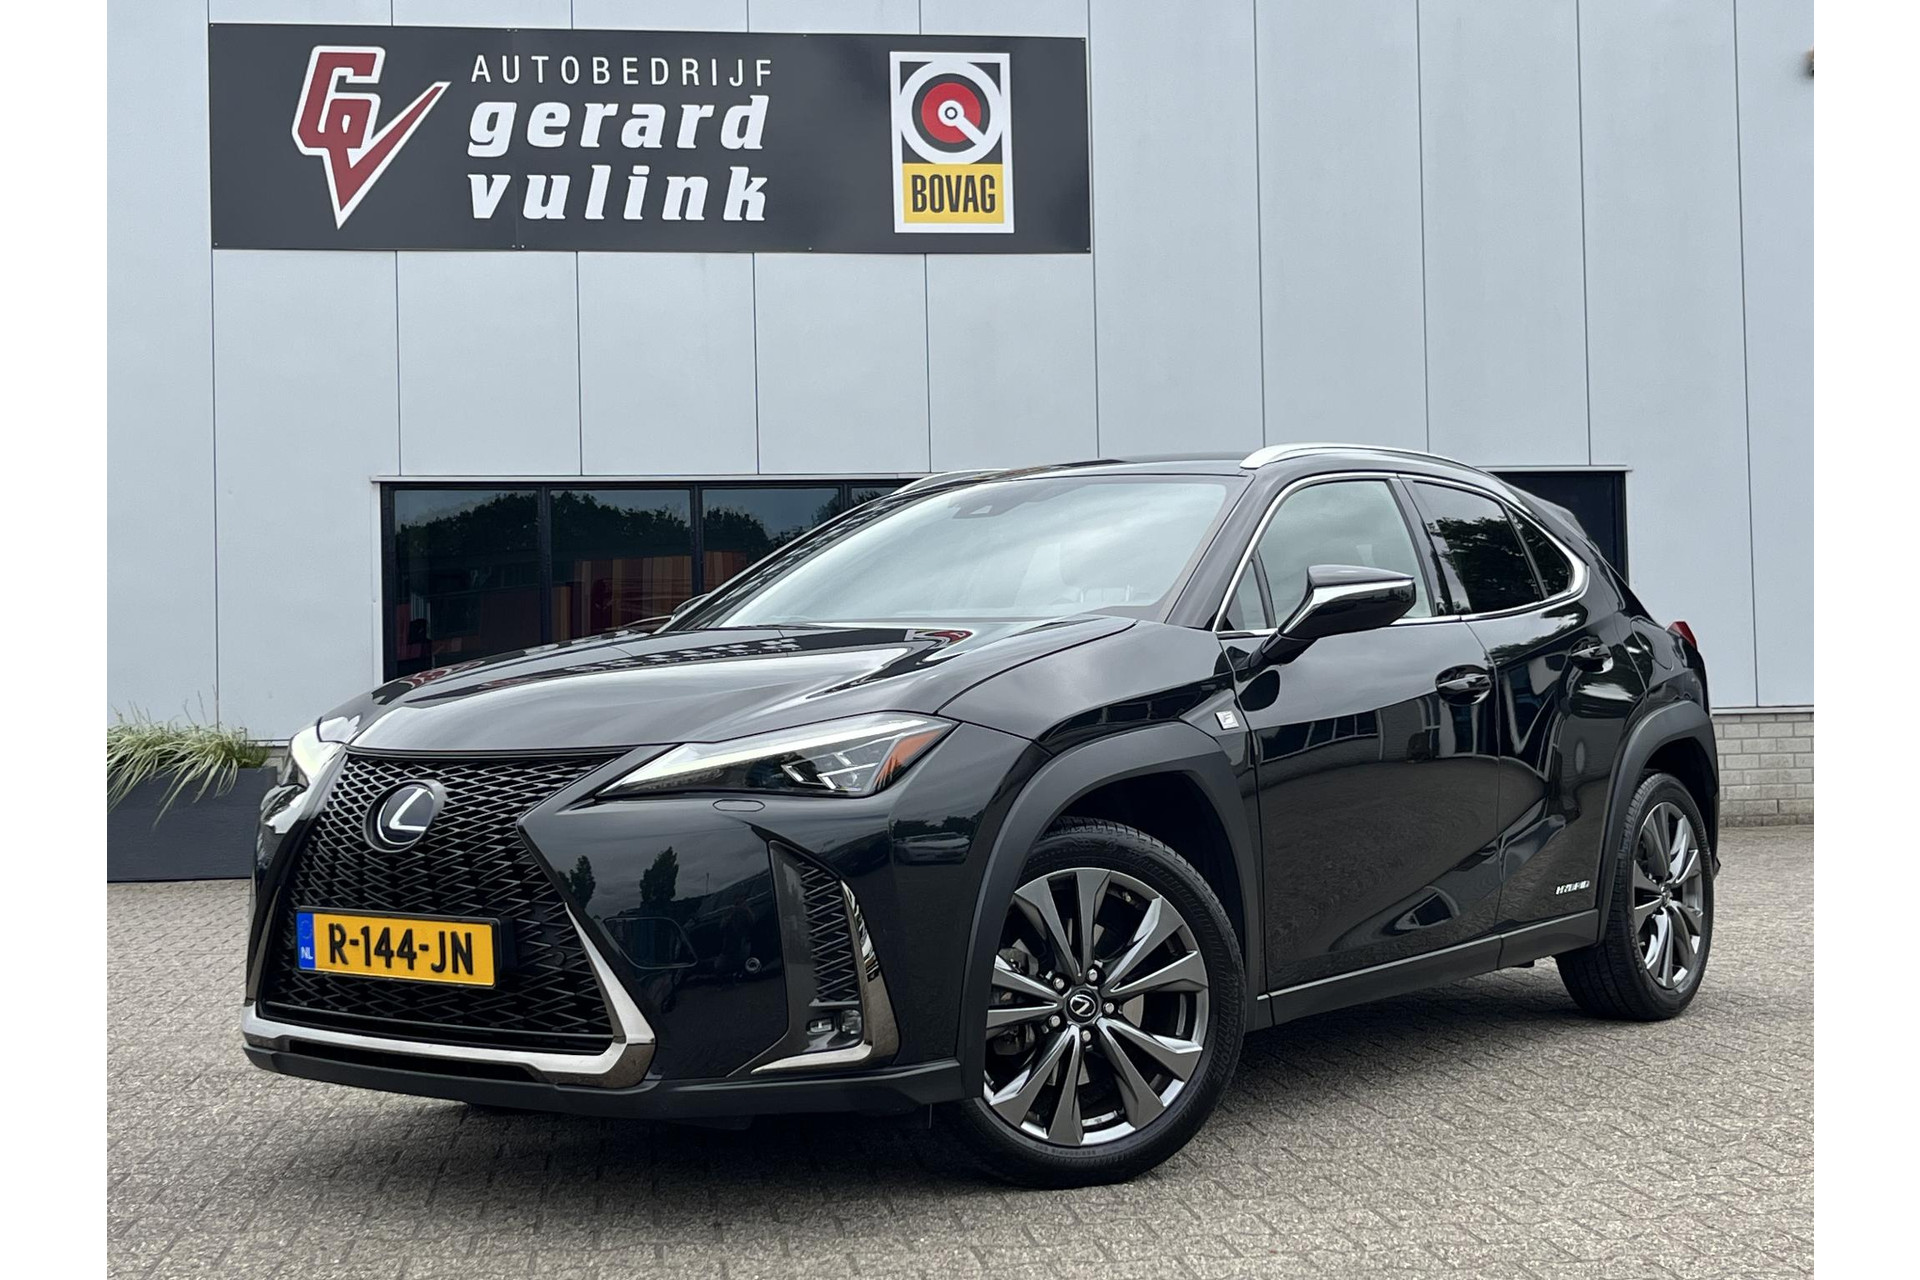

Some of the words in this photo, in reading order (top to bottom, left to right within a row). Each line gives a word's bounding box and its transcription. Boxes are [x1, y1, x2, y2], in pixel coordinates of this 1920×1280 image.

[471, 54, 772, 87] AUTOBEDRIJF
[467, 95, 769, 158] gerard
[467, 165, 768, 222] vulink
[911, 174, 996, 213] BOVAG
[301, 946, 313, 961] NL
[328, 922, 474, 975] R-144-JN
